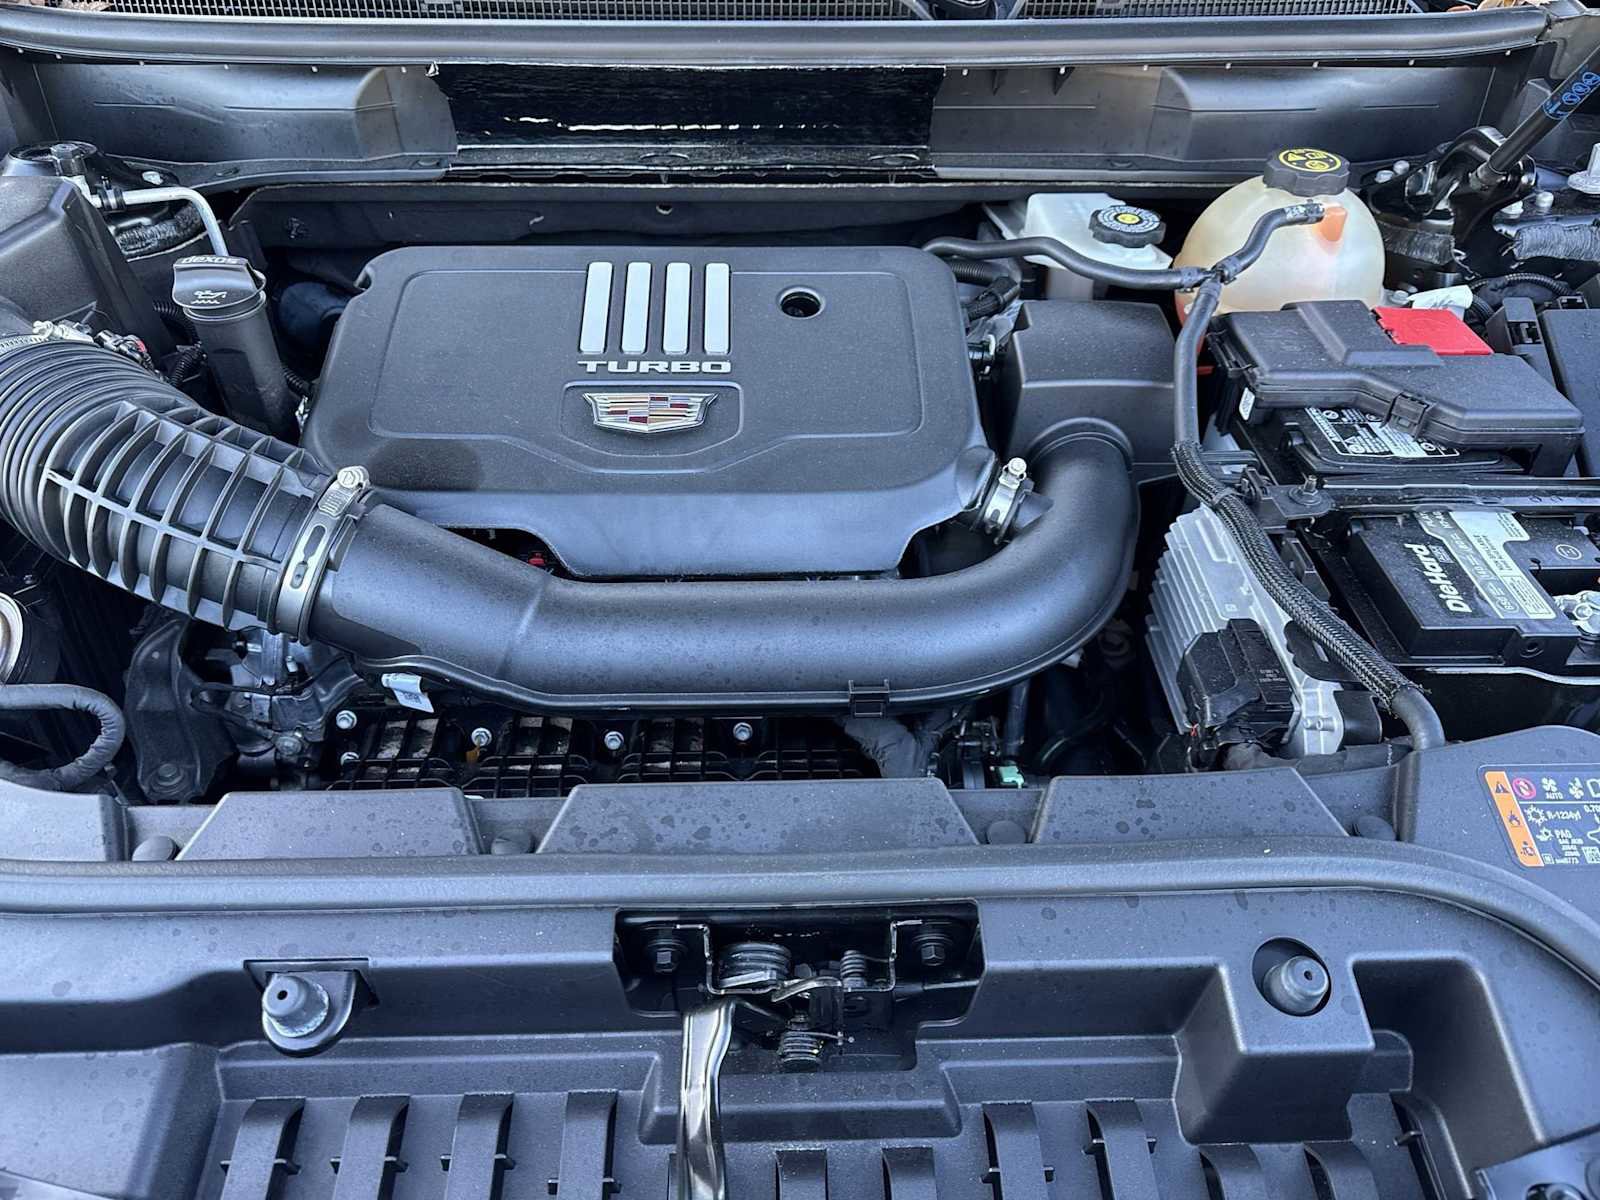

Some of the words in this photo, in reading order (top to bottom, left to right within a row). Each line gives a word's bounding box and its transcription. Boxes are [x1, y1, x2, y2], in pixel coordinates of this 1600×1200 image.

[181, 256, 239, 264] dexos
[577, 360, 732, 373] TURBO
[1403, 543, 1472, 612] DieHard
